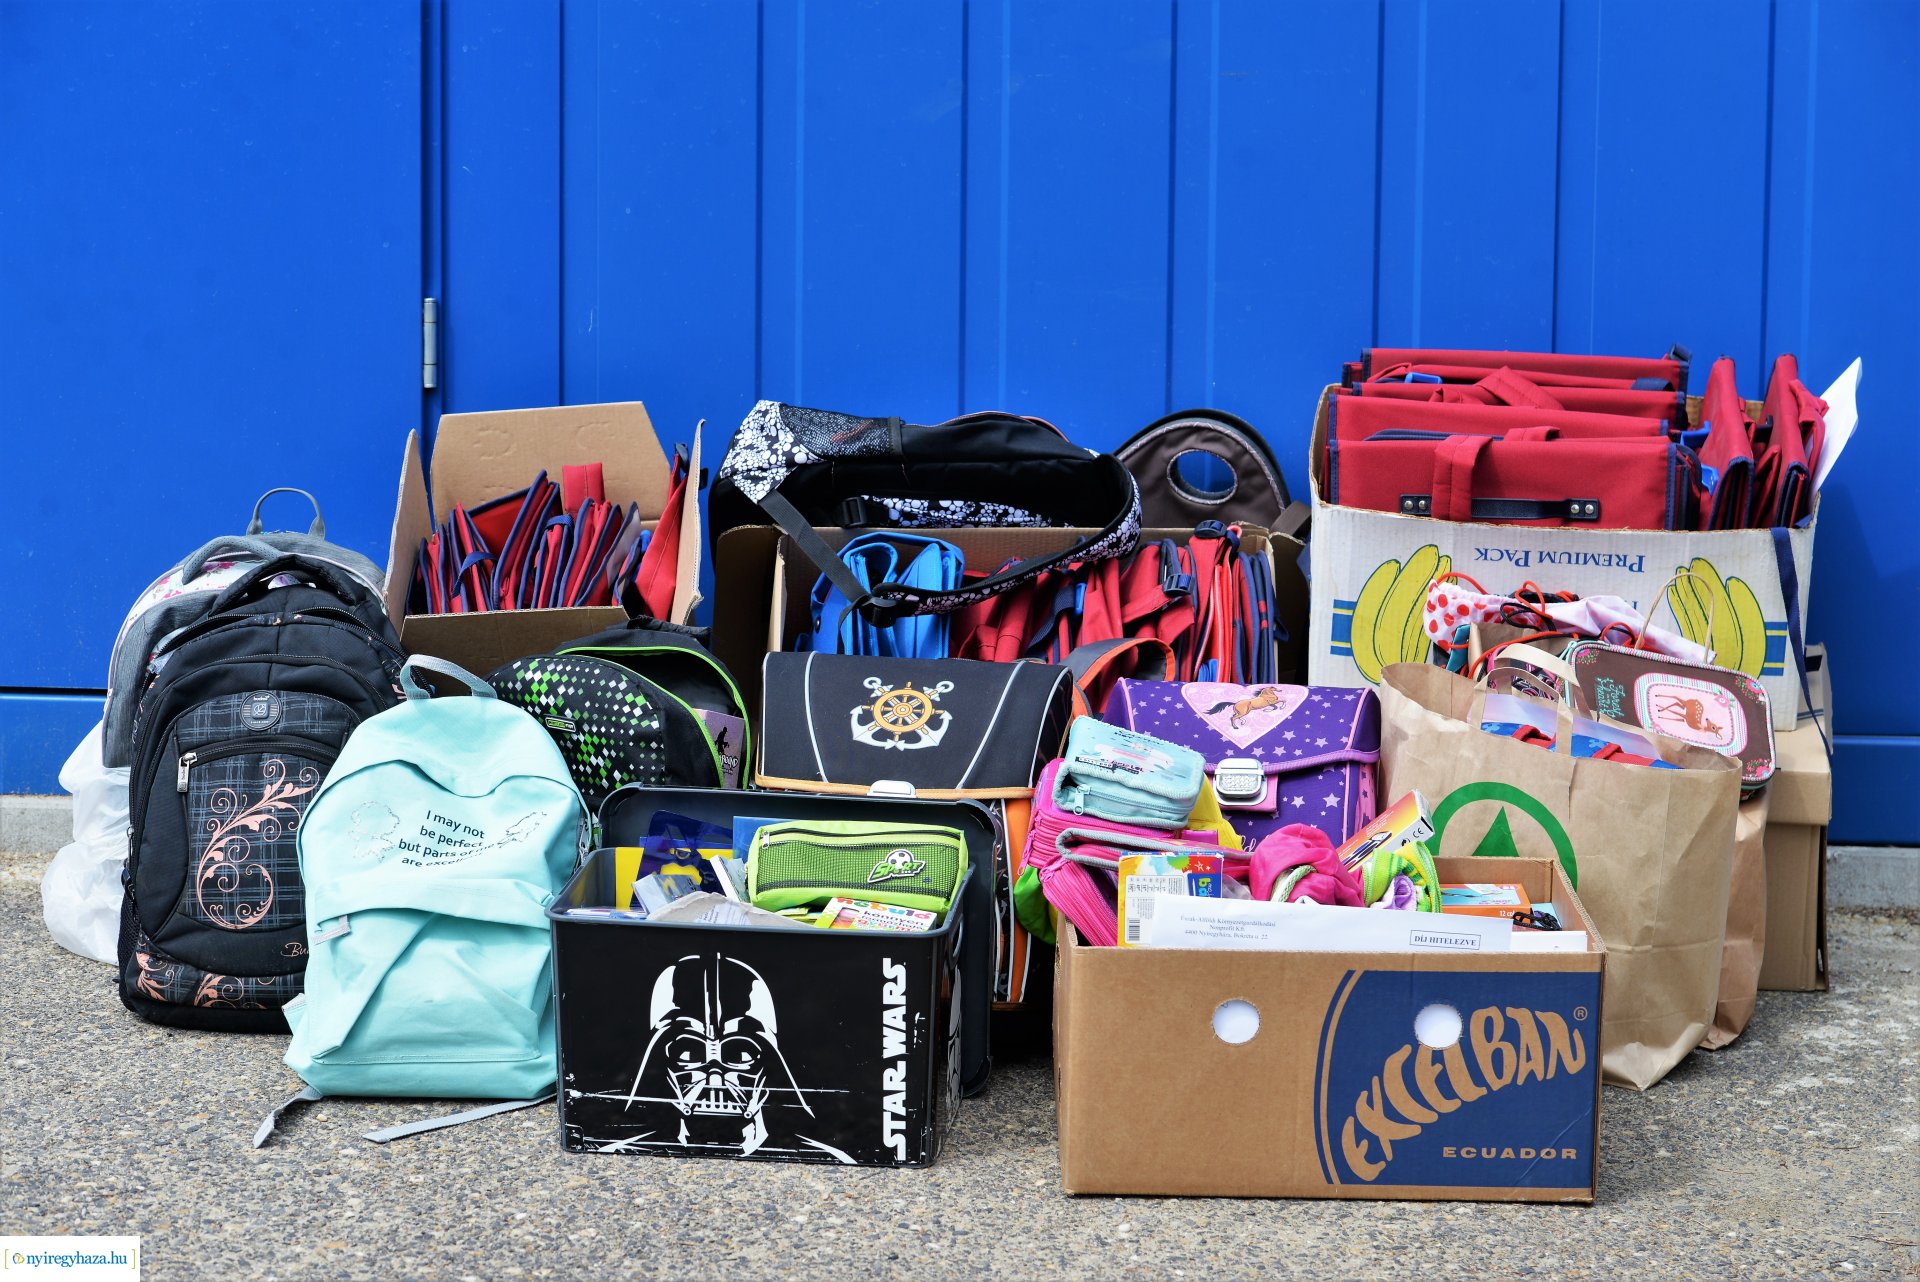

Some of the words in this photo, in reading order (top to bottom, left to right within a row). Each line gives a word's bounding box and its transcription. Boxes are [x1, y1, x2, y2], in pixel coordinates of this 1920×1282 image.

[1474, 547, 1532, 568] PACK
[1537, 550, 1646, 573] PREMIUM
[426, 810, 431, 820] I
[434, 813, 462, 832] may
[463, 824, 485, 839] not
[419, 825, 436, 839] be
[437, 832, 484, 848] perfect
[398, 838, 422, 853] but
[423, 845, 457, 858] parts
[401, 856, 423, 868] are
[1429, 936, 1477, 946] HITELEZVE
[883, 957, 907, 1059] WARS
[883, 1061, 907, 1161] STAR
[1443, 1146, 1577, 1160] ECUADOR
